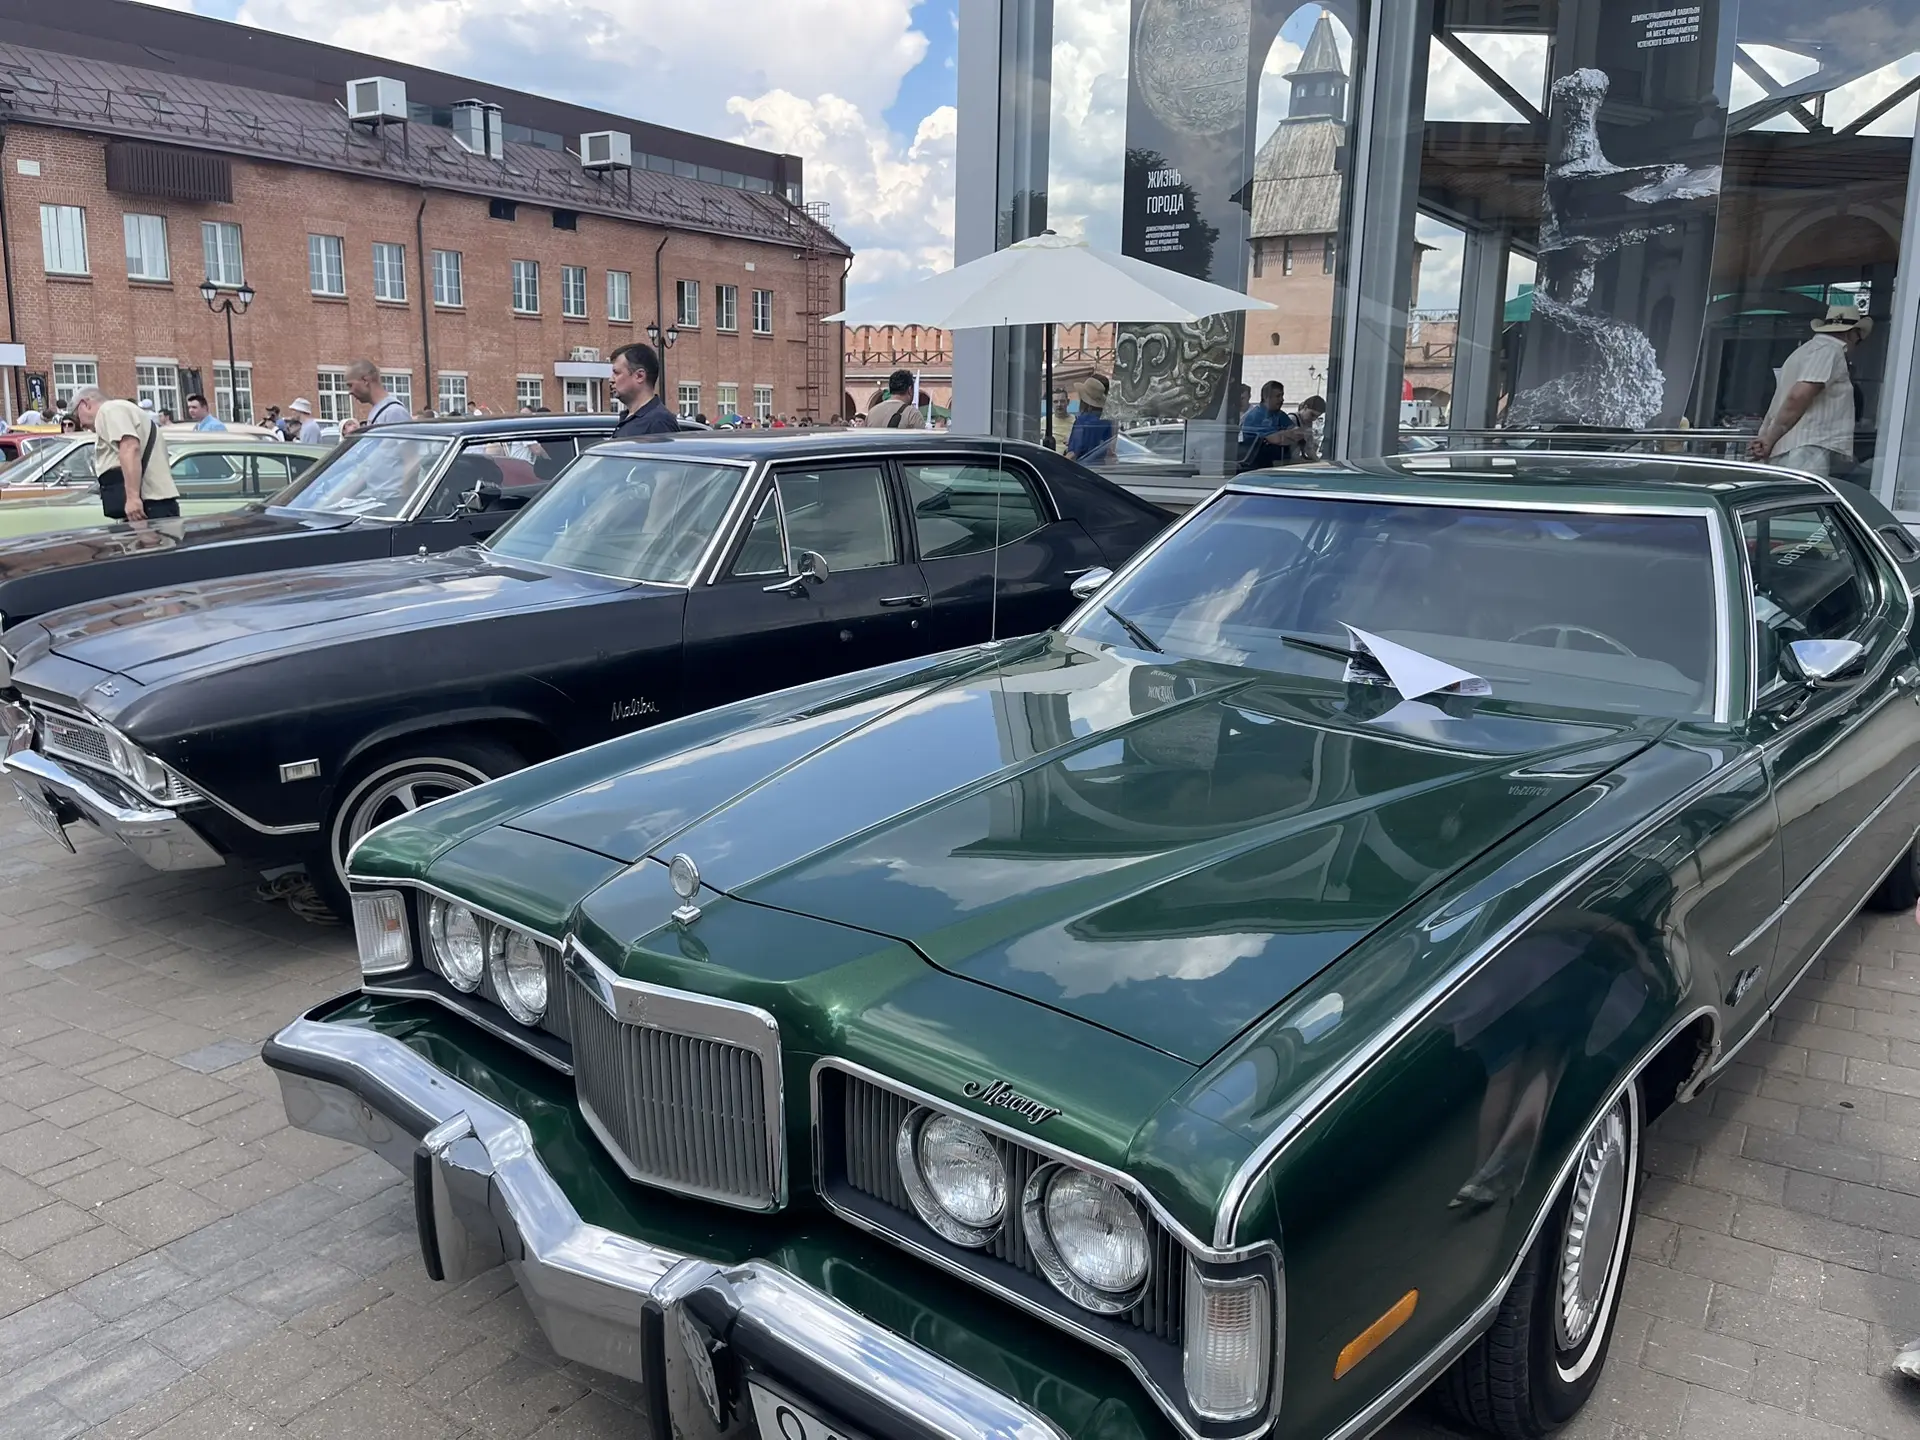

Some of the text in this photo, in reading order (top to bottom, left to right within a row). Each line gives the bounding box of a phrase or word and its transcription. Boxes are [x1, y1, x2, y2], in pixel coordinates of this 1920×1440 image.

[1147, 169, 1181, 188] ЖИЗНЬ
[1146, 193, 1184, 215] ГОРОДА
[611, 697, 660, 721] Malibu
[962, 1079, 1063, 1125] Mercury
